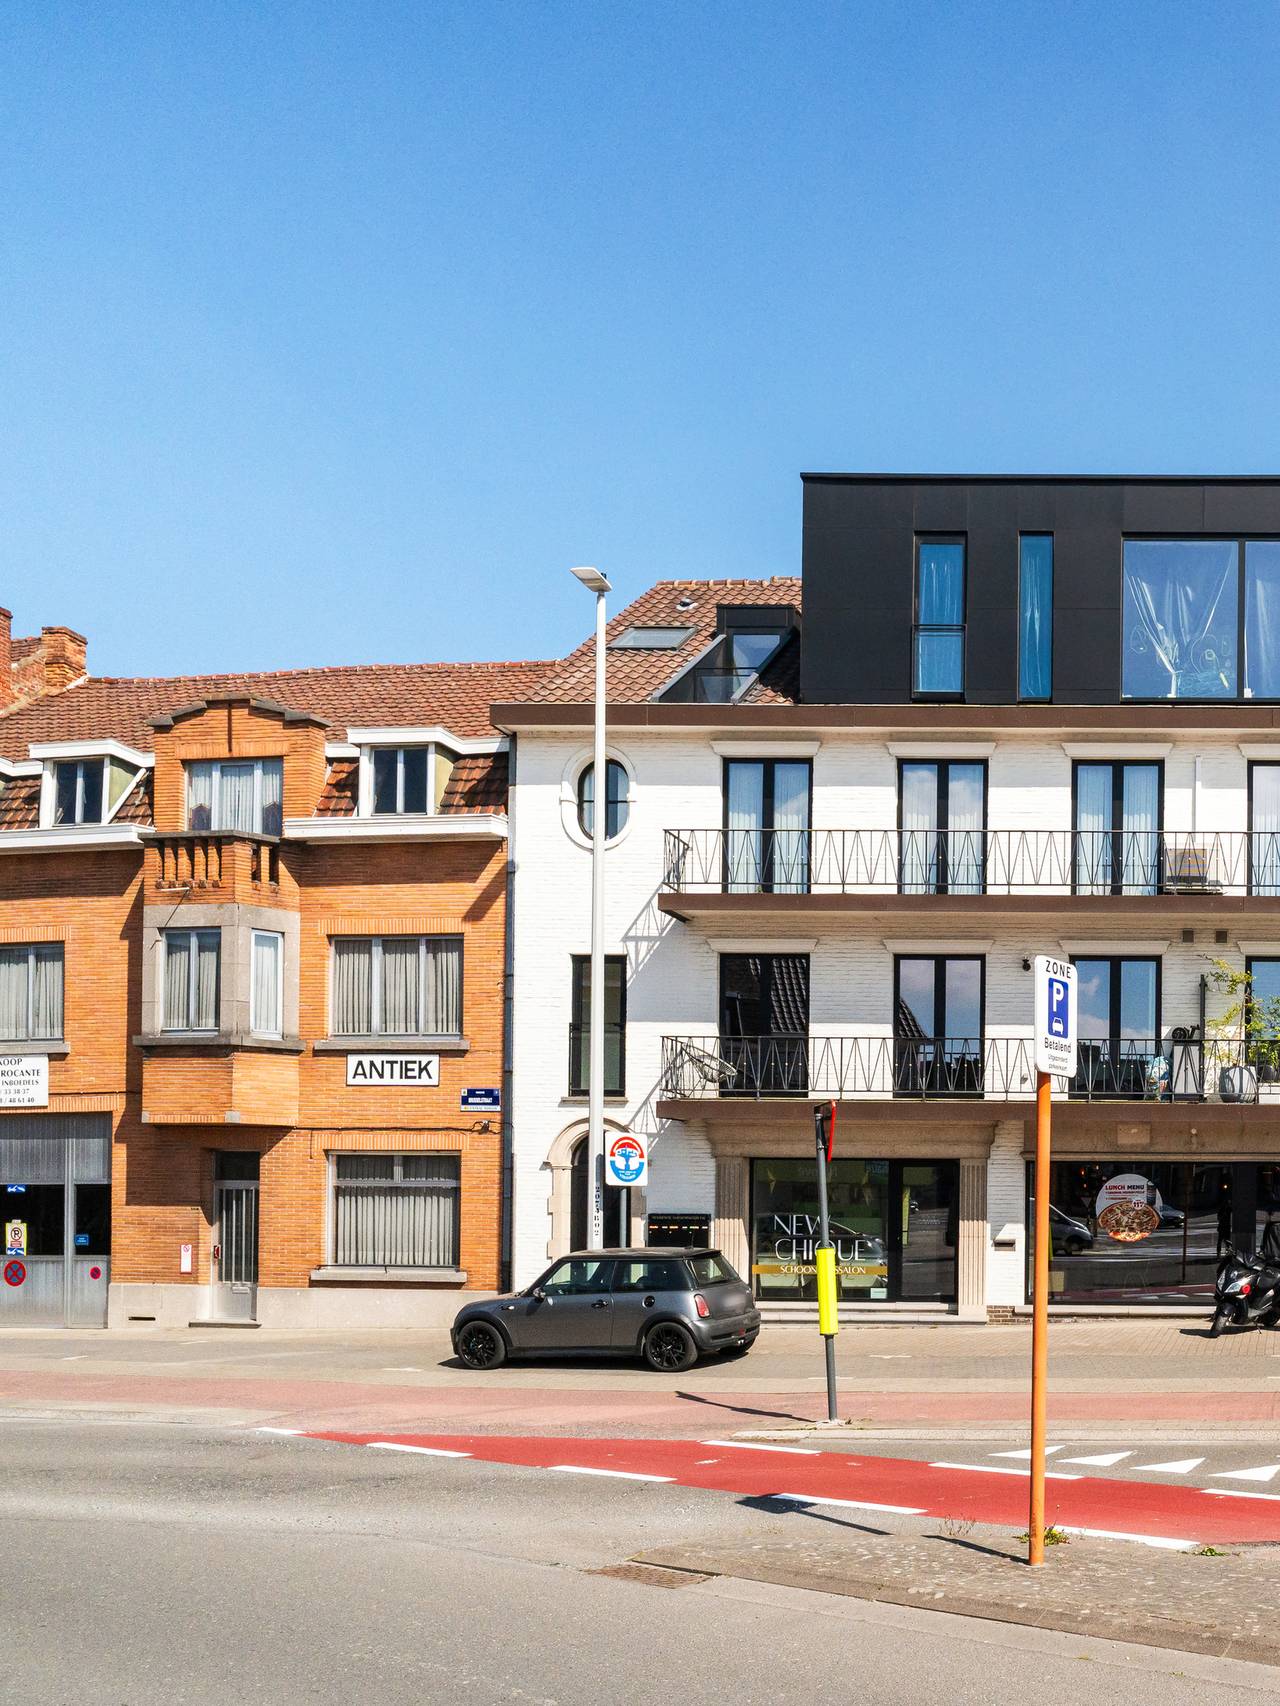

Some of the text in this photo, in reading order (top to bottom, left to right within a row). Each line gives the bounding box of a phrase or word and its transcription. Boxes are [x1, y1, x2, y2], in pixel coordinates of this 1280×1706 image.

[1046, 960, 1072, 979] ZONE
[1044, 1037, 1072, 1053] Betalend
[0, 1069, 41, 1077] ROCANTE
[352, 1060, 433, 1080] ANTIEK
[774, 1215, 832, 1235] NEW
[780, 1265, 866, 1274] SCHOONSSALON
